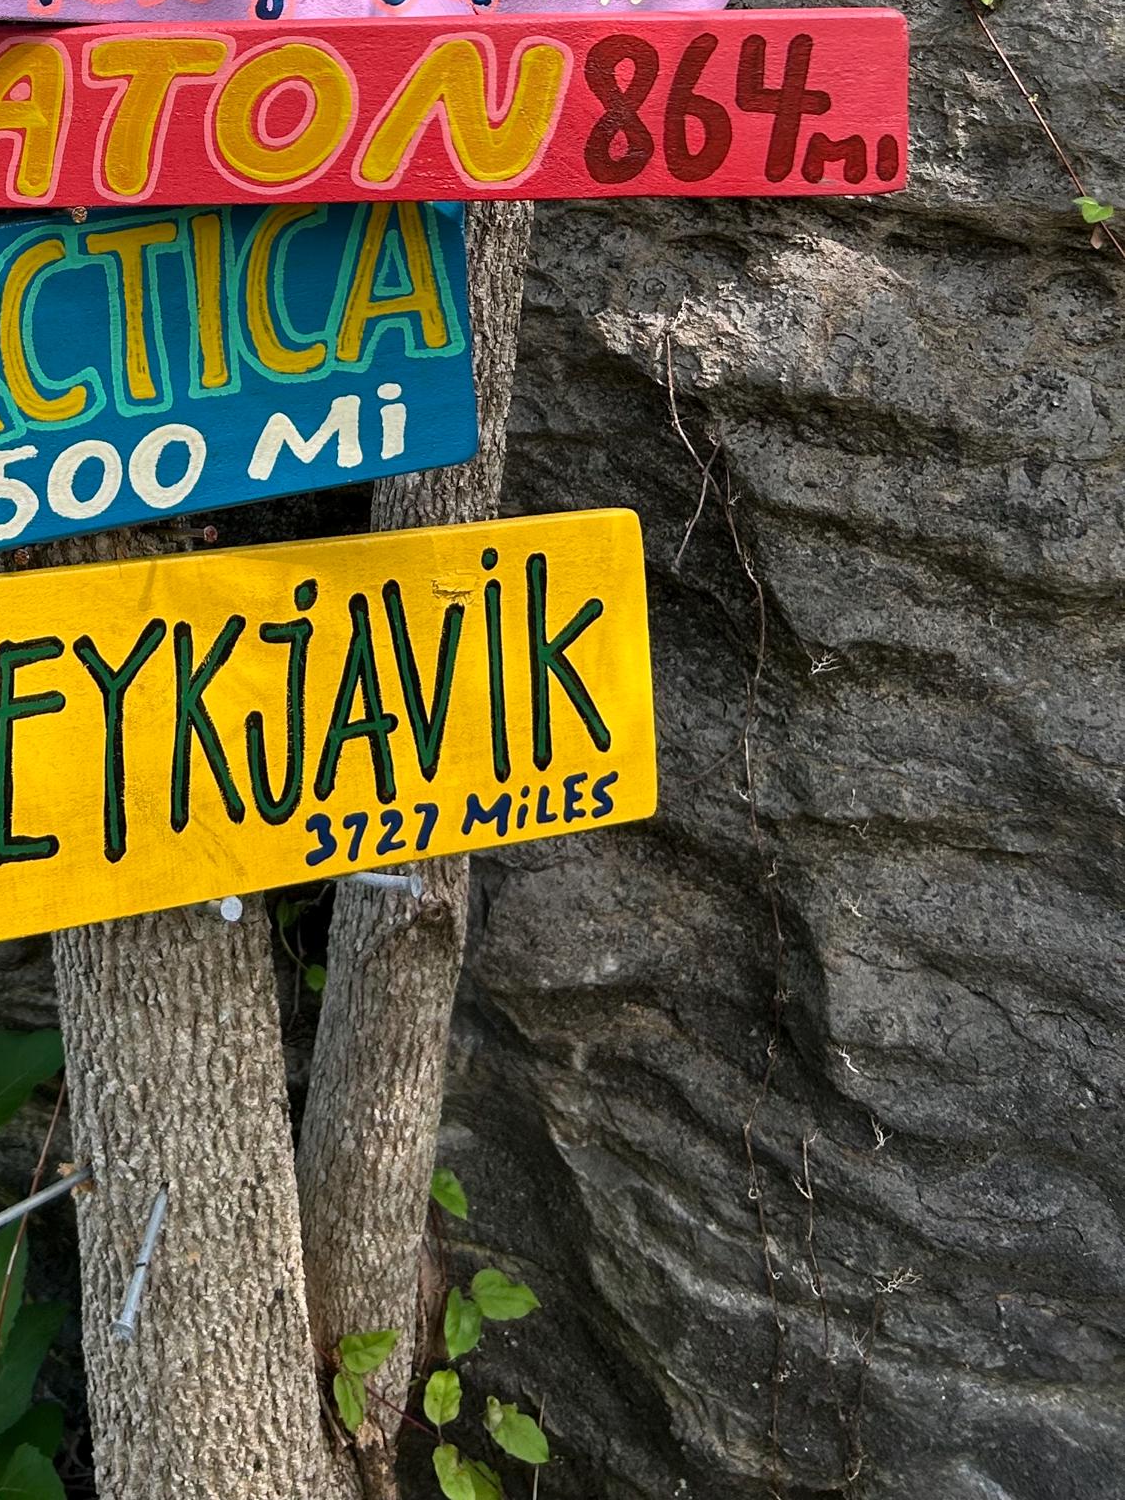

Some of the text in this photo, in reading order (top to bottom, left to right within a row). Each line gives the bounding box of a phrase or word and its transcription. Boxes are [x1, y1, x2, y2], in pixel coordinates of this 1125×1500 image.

[584, 31, 832, 185] 864
[246, 382, 408, 482] Mi
[304, 802, 440, 868] 3727
